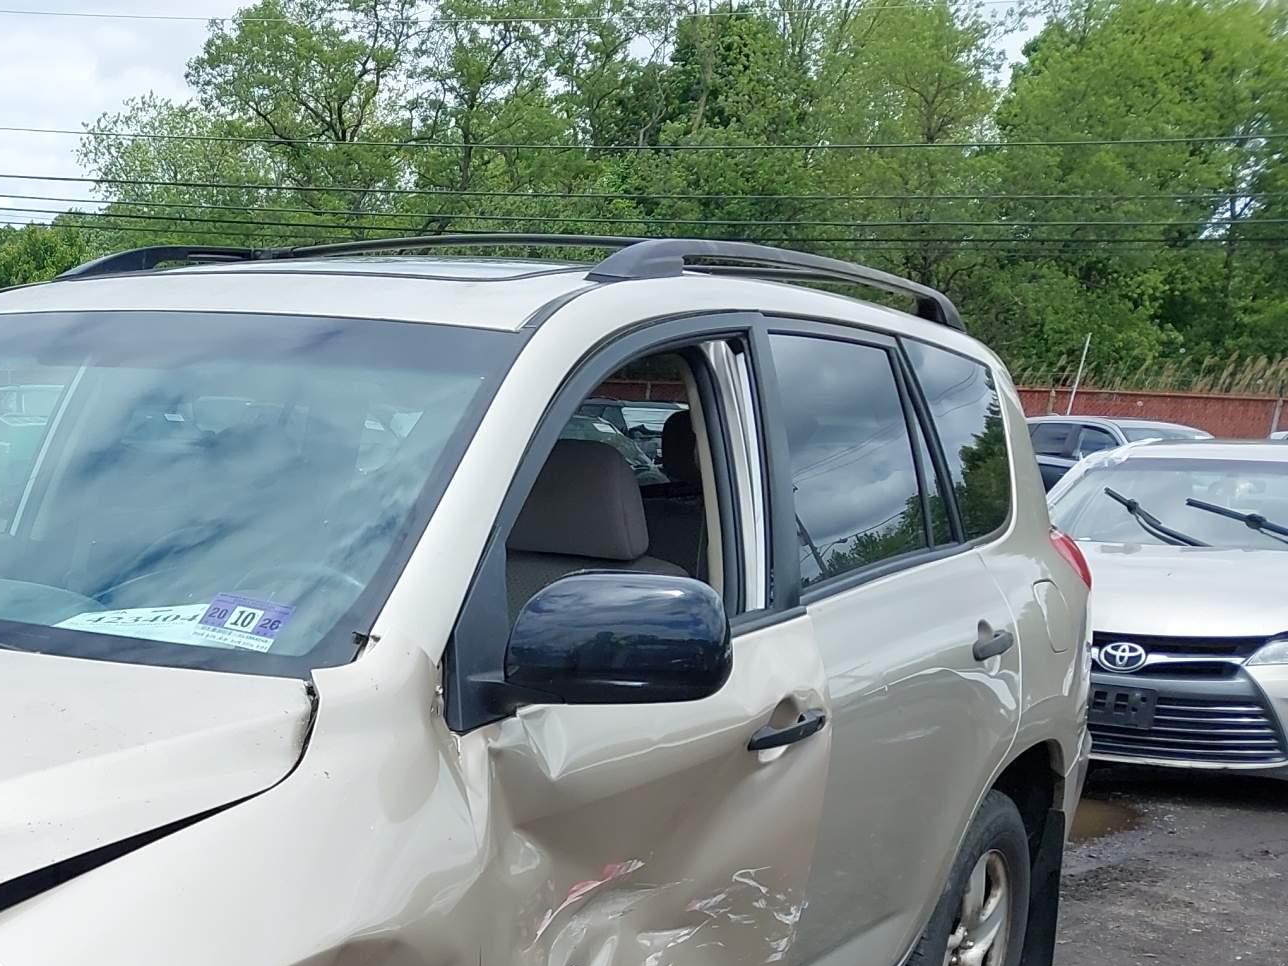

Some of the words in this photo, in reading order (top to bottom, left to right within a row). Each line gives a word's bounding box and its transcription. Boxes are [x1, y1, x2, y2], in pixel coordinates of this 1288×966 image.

[207, 607, 229, 620] 20
[230, 610, 256, 628] 10
[259, 618, 281, 631] 26
